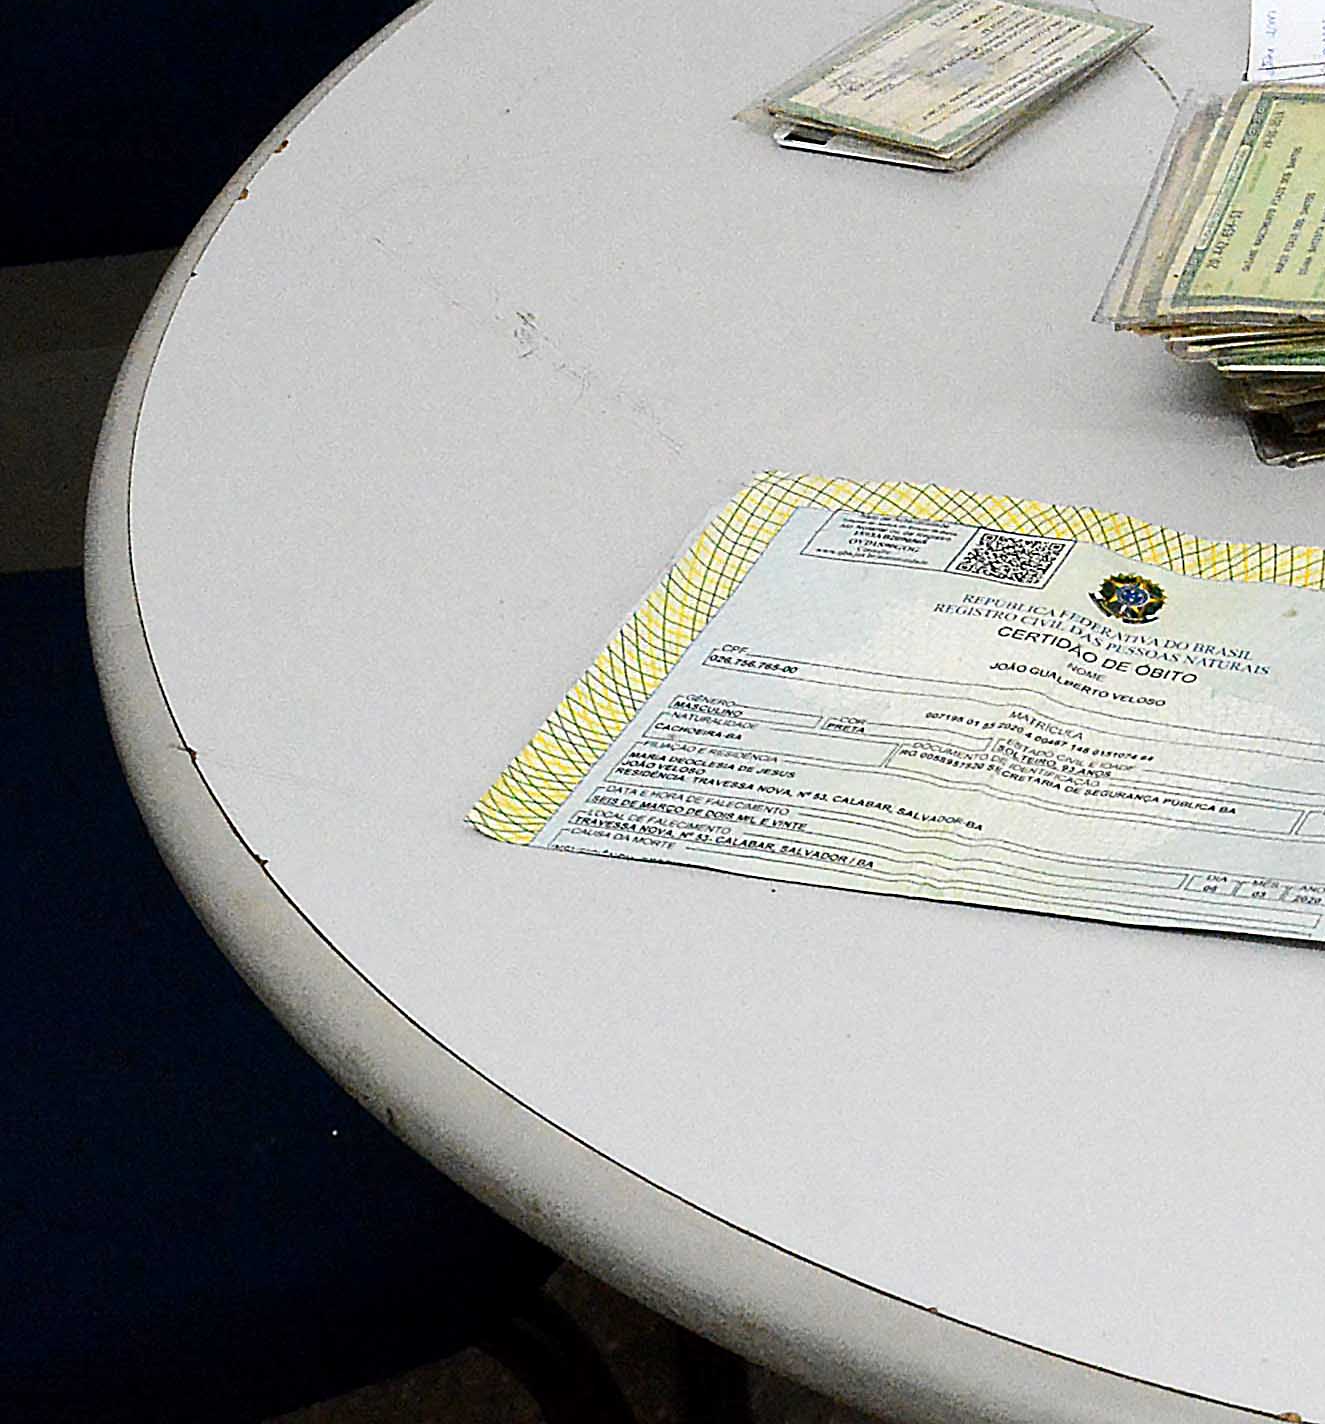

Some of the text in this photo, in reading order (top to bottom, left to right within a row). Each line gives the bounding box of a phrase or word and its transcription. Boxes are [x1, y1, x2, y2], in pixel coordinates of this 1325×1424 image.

[933, 602, 1271, 676] REGISTRO CIVIL DAS PESSOAS NATURAIS
[1058, 607, 1159, 648] FEDERATIVA
[1163, 638, 1190, 650] DO
[1192, 642, 1253, 662] BRASIL
[721, 643, 748, 654] CPF
[998, 625, 1198, 685] CERTIDÃO DE ÓBITO
[990, 660, 1167, 707] JOÃO GUALBERTO VELOSO
[1067, 662, 1105, 682] NOME
[673, 700, 744, 718] MASCULINO
[826, 722, 866, 734] PRETA
[621, 758, 706, 775] JOÃO VELOSO
[629, 751, 666, 762] MARIA
[737, 765, 753, 773] DE
[755, 768, 796, 778] JESUS
[1076, 767, 1111, 778] ANOS
[692, 777, 754, 791] TRAVESSA
[987, 764, 1061, 790] SECRETARIA
[1064, 786, 1082, 796] DE
[1084, 788, 1160, 806] SEGURANÇA
[1163, 795, 1216, 811] PÚBLICA
[1219, 806, 1237, 815] BA
[590, 794, 621, 805] SEIS
[622, 799, 641, 809] DE
[642, 802, 684, 816] MARÇO
[686, 807, 703, 817] DE
[705, 809, 735, 821] DOIS
[771, 819, 808, 831] VINTE
[603, 784, 637, 796] DATA
[649, 790, 685, 803] HORA
[686, 796, 701, 805] DE
[702, 797, 790, 816] FALECIMENTO
[587, 809, 625, 822] LOCAL
[646, 816, 732, 835] FALECIMENTO
[571, 827, 675, 850] CAUSA DA MORTE
[575, 815, 636, 833] TRAVESSA
[779, 845, 849, 863] SALVADOR
[857, 858, 874, 869] BA
